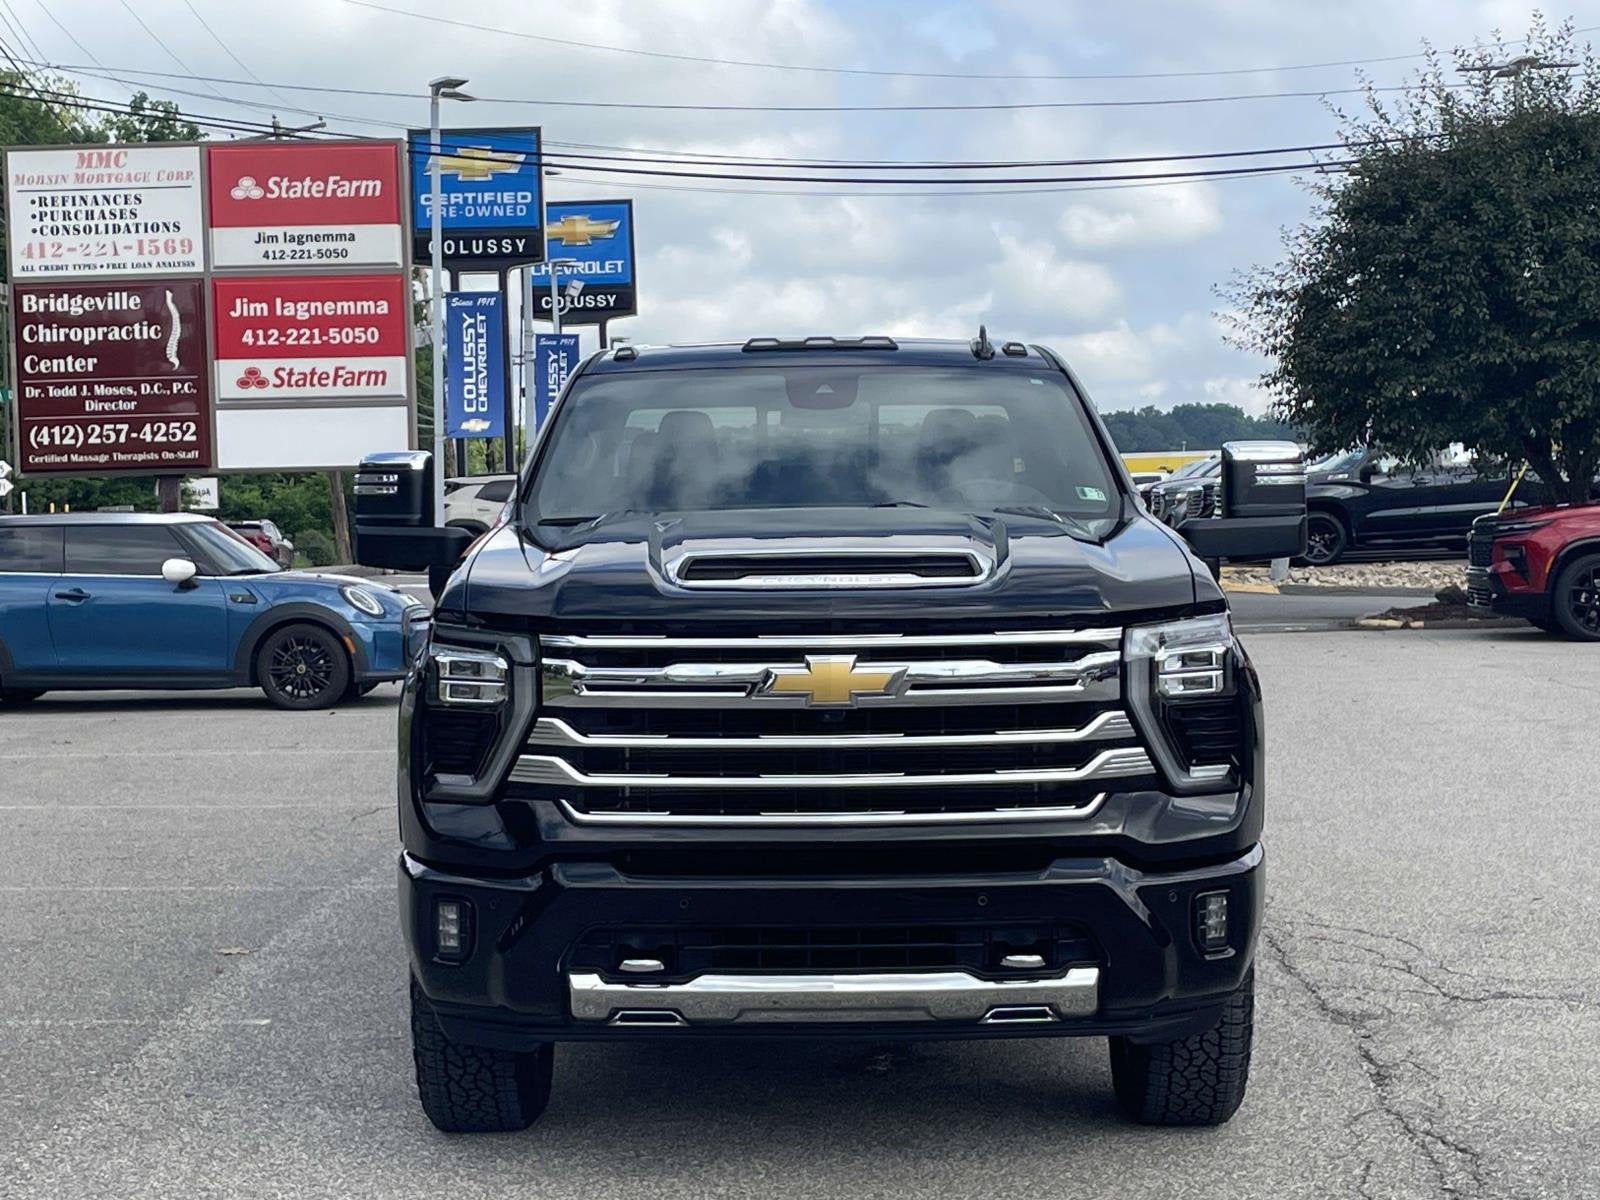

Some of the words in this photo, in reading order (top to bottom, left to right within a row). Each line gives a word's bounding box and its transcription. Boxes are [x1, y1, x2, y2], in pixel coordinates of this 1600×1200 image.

[76, 151, 128, 169] MMC
[74, 171, 151, 184] MORTGAGE
[38, 193, 143, 208] REFINANCES
[420, 191, 532, 205] CERTIFIED
[38, 208, 138, 222] PURCHASES
[39, 221, 181, 237] CONSOLIDATIONS
[254, 232, 279, 244] Jim
[283, 232, 356, 246] Iagnemma
[21, 238, 194, 259] 412-221-1569
[262, 248, 348, 260] 412-221-5050
[39, 263, 69, 272] CREDIT
[73, 263, 97, 271] TYPES
[106, 262, 127, 270] FREE
[131, 262, 152, 270] LOAN
[156, 260, 196, 269] ANALYSIS
[22, 292, 141, 315] Bridgeville
[229, 298, 268, 317] Jim
[275, 298, 389, 320] Iagnemma
[22, 321, 162, 345] Chiropractic
[242, 327, 380, 345] 412-221-5050
[23, 355, 98, 374] Center
[463, 312, 477, 413] COLUSSY
[477, 312, 488, 412] CHEVROLET
[25, 386, 45, 399] Dr.
[47, 385, 77, 398] Todd
[80, 384, 91, 397] J.
[94, 383, 138, 397] Moses,
[172, 382, 197, 394] P.C.
[85, 400, 138, 412] Director
[29, 424, 85, 449] (412)
[87, 422, 197, 444] 257-4252
[29, 453, 68, 464] Certified
[70, 452, 109, 464] Massage
[113, 451, 159, 463] Therapists
[162, 450, 199, 460] On-Staff
